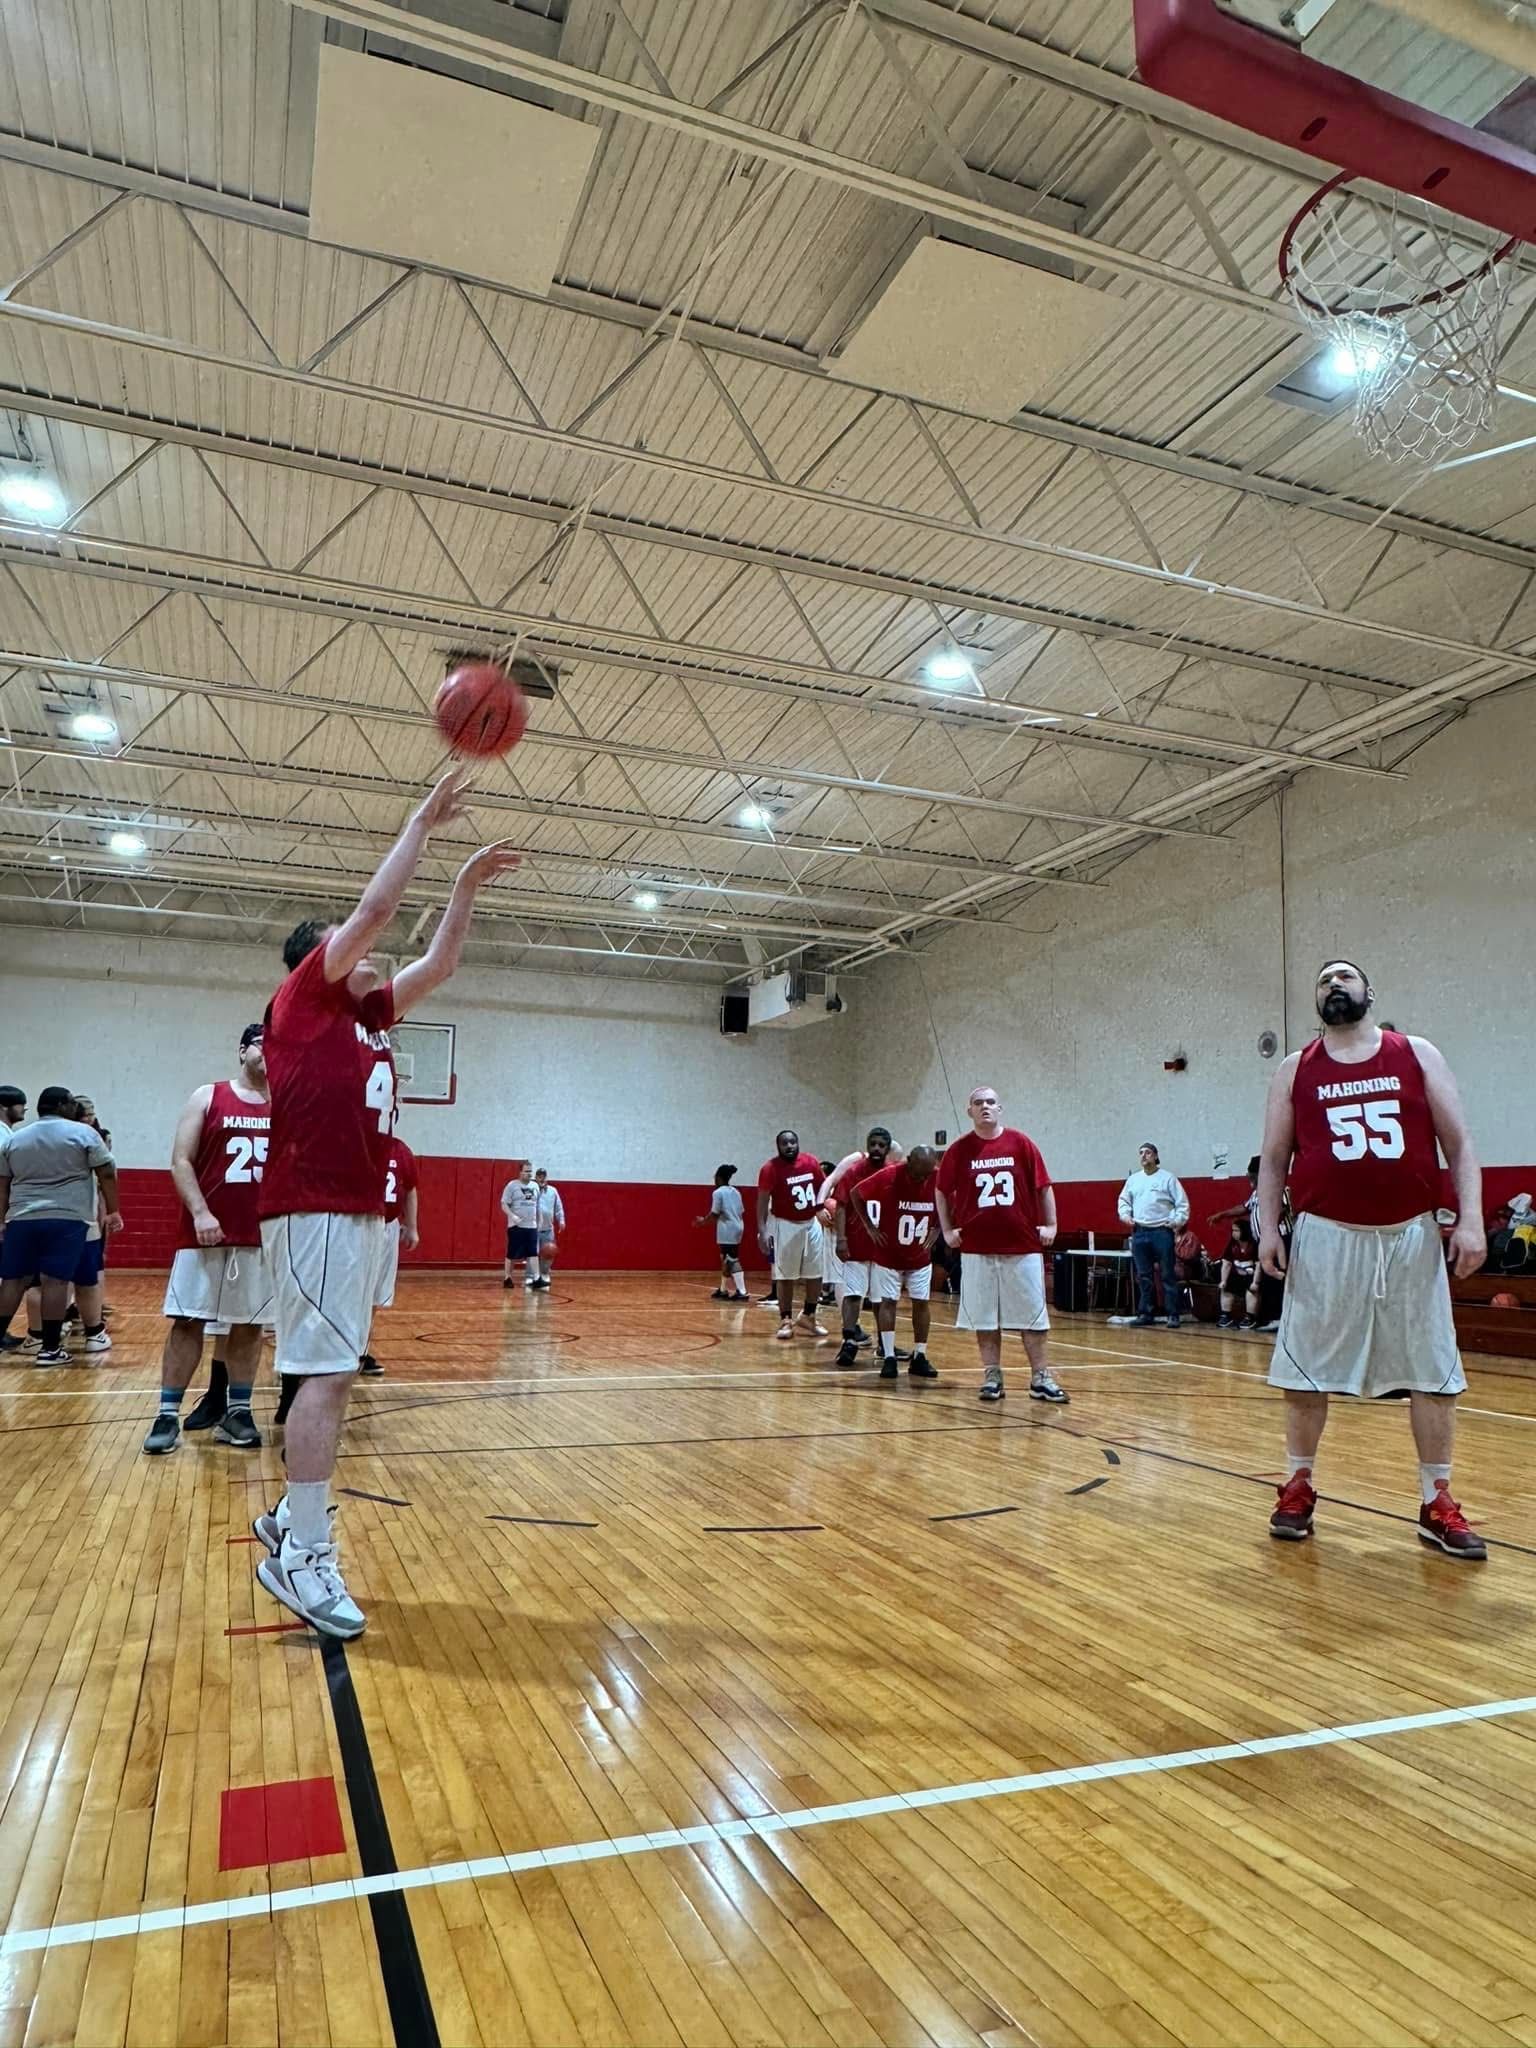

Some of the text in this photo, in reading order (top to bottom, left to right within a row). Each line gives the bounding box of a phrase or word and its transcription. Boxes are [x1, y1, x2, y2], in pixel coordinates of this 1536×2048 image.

[365, 1061, 394, 1135] 4
[1317, 1076, 1401, 1100] MAHONING
[1326, 1099, 1405, 1161] 55
[225, 1136, 269, 1184] 25
[791, 1182, 816, 1210] 34
[975, 1171, 1015, 1208] 23
[897, 1214, 929, 1246] 04
